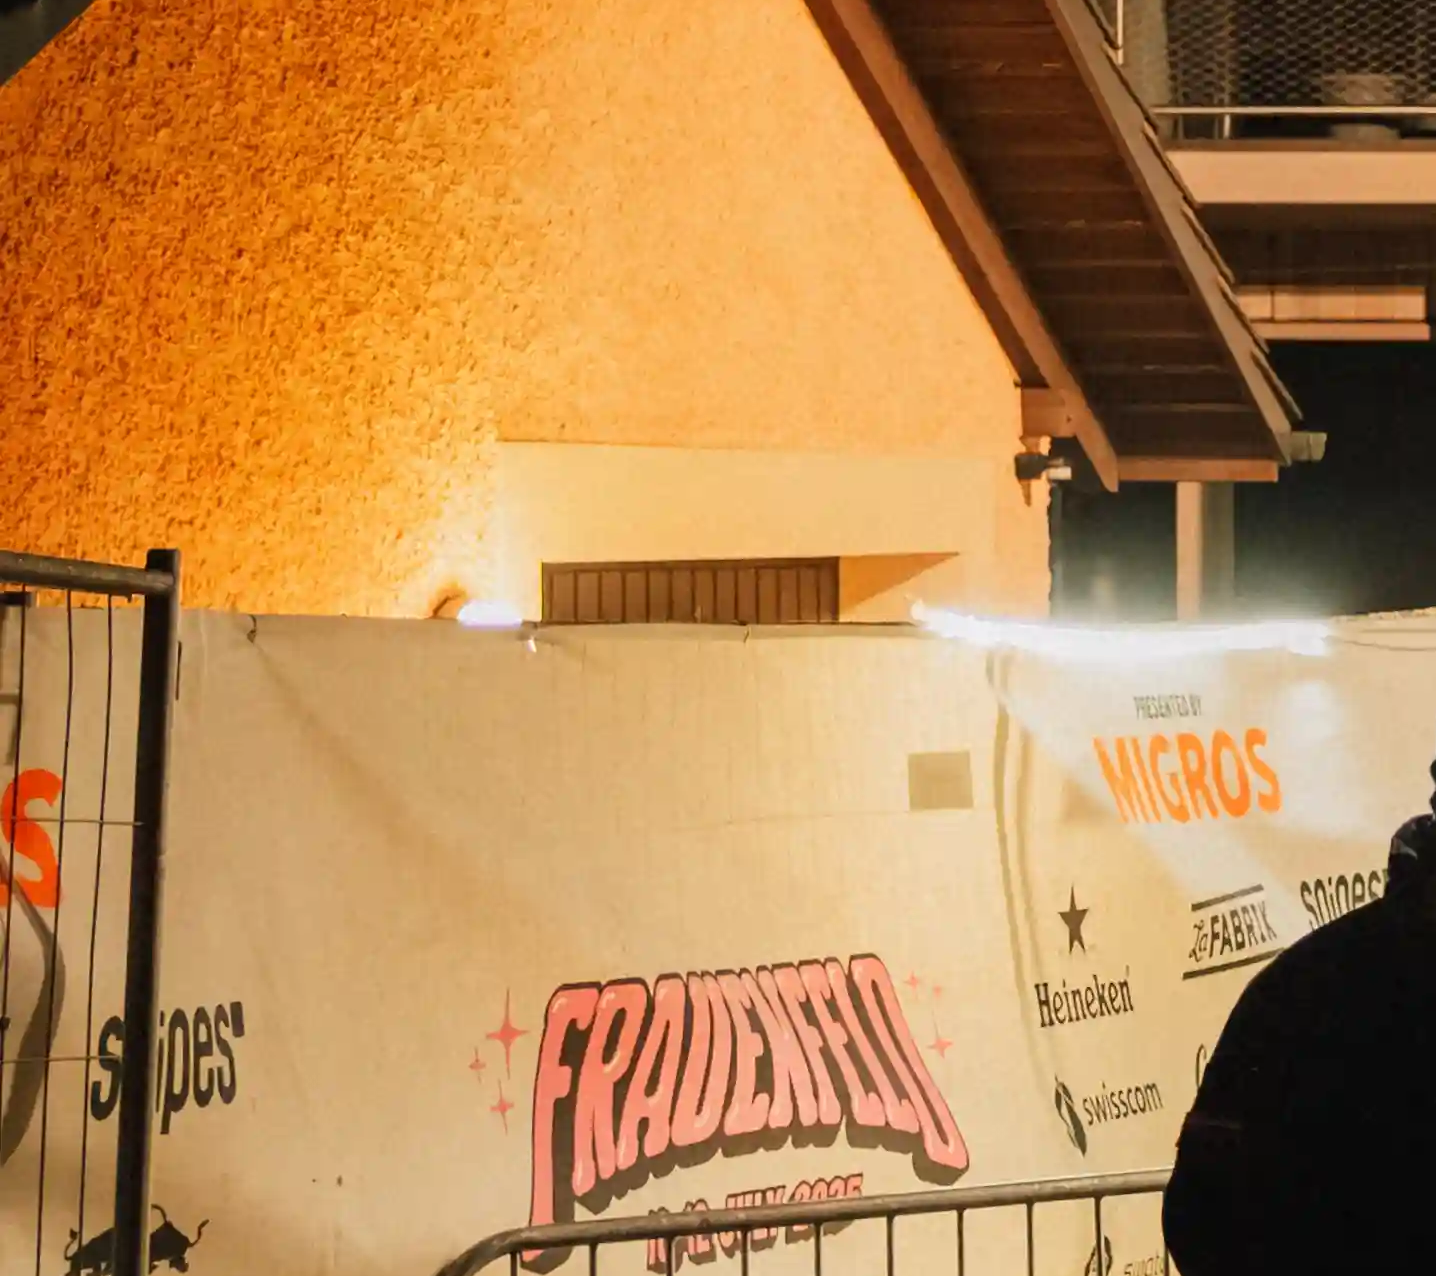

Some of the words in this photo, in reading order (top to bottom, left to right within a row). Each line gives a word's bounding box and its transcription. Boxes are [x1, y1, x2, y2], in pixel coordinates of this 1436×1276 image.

[1093, 727, 1283, 824] MIGROS
[1209, 899, 1278, 960] FABRIK
[1034, 973, 1135, 1029] Heineken
[519, 952, 970, 1275] FRAUENFELD
[1082, 1080, 1164, 1127] swisscom
